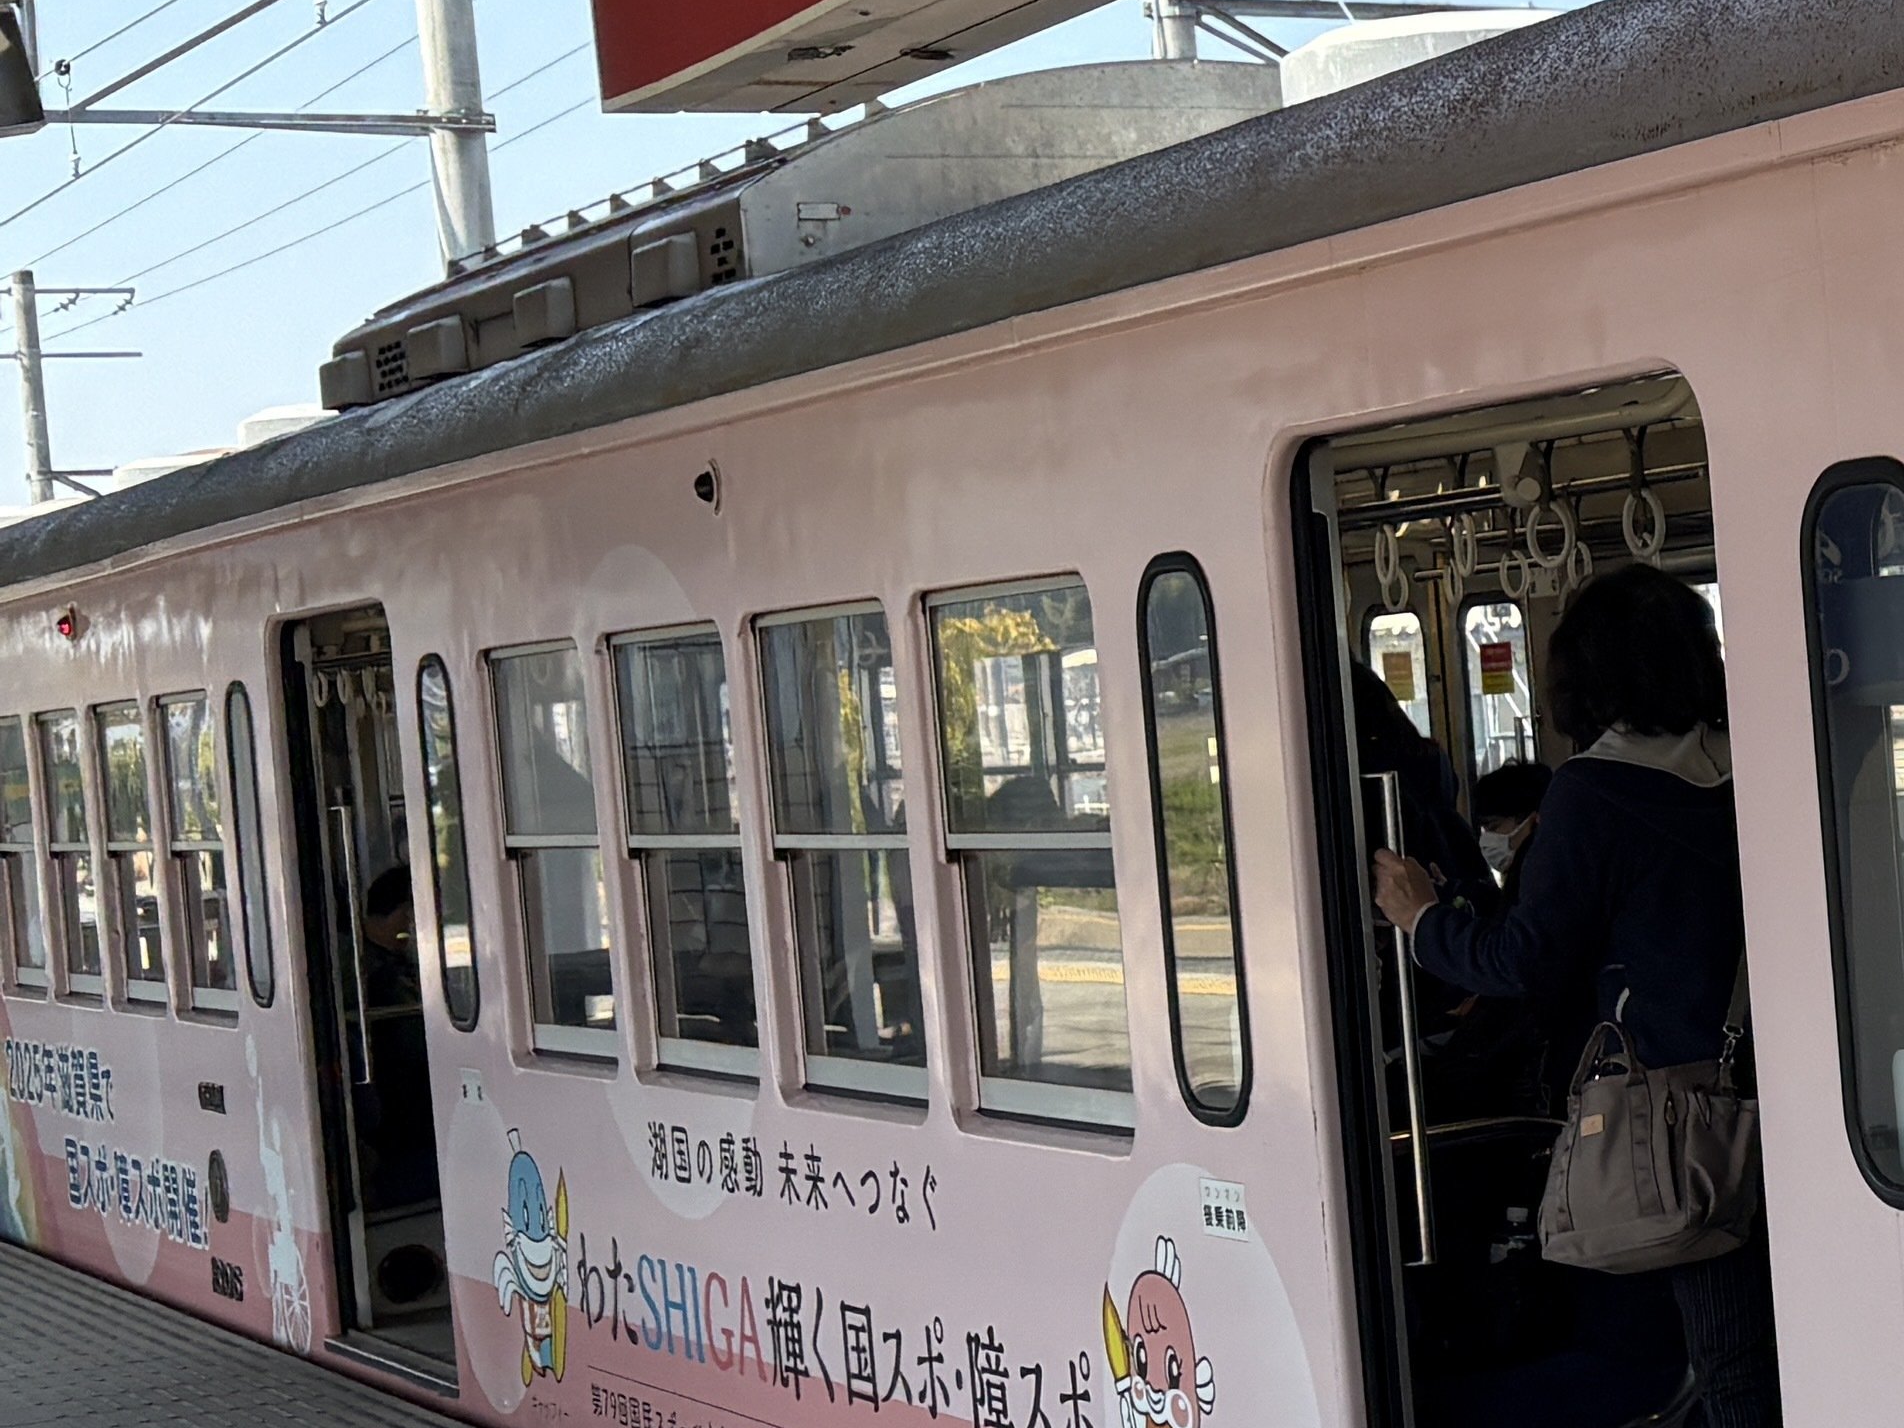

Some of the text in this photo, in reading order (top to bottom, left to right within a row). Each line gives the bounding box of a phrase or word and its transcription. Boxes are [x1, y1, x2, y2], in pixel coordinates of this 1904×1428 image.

[6, 1039, 113, 1120] 2025年滋賀県で
[648, 1122, 937, 1230] 湖国の感動 未来へつなぐ
